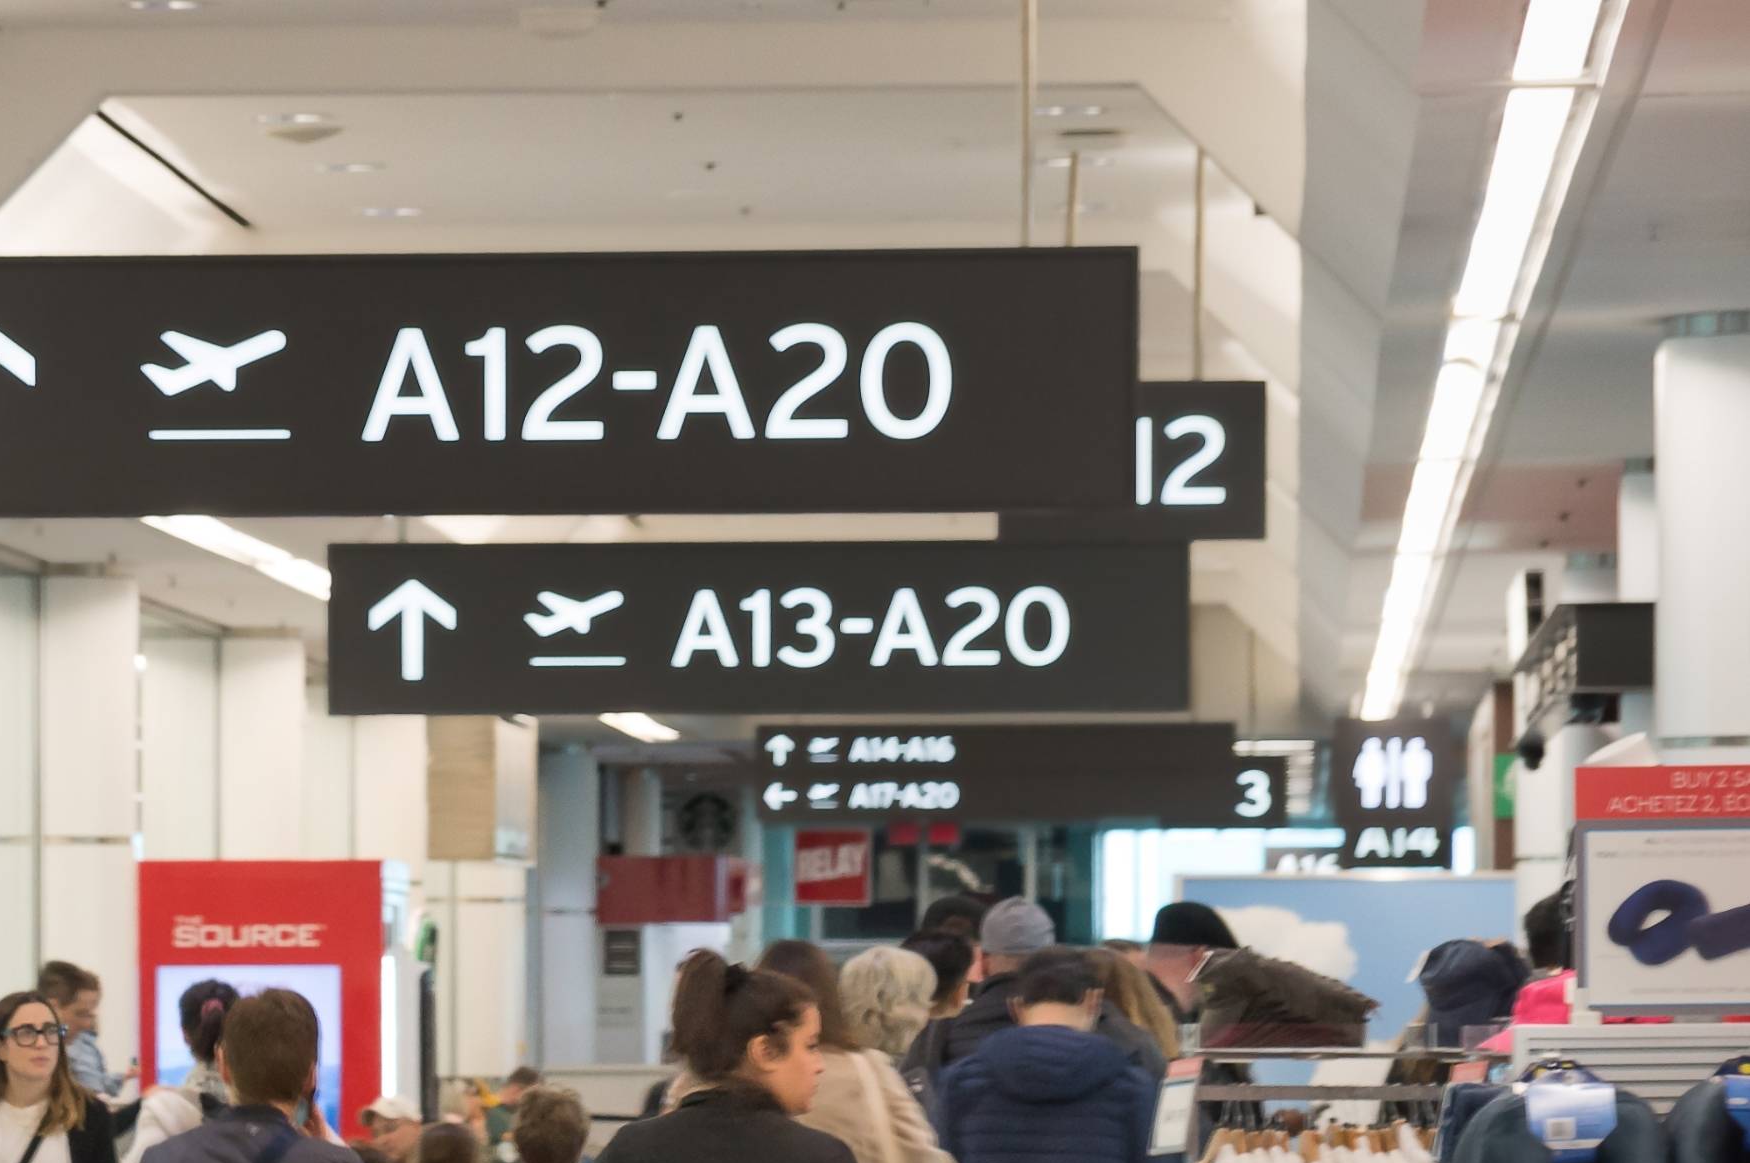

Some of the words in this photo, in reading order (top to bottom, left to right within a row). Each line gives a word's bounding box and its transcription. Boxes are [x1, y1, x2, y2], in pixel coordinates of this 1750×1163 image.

[361, 321, 953, 443] A12-A20
[670, 585, 1071, 668] A13-A20
[1235, 769, 1272, 817] 3
[1671, 771, 1714, 789] BUY
[1715, 770, 1729, 788] 2
[1605, 794, 1699, 813] ACHETEZ
[1354, 827, 1440, 858] A14
[172, 924, 323, 948] SOURCE
